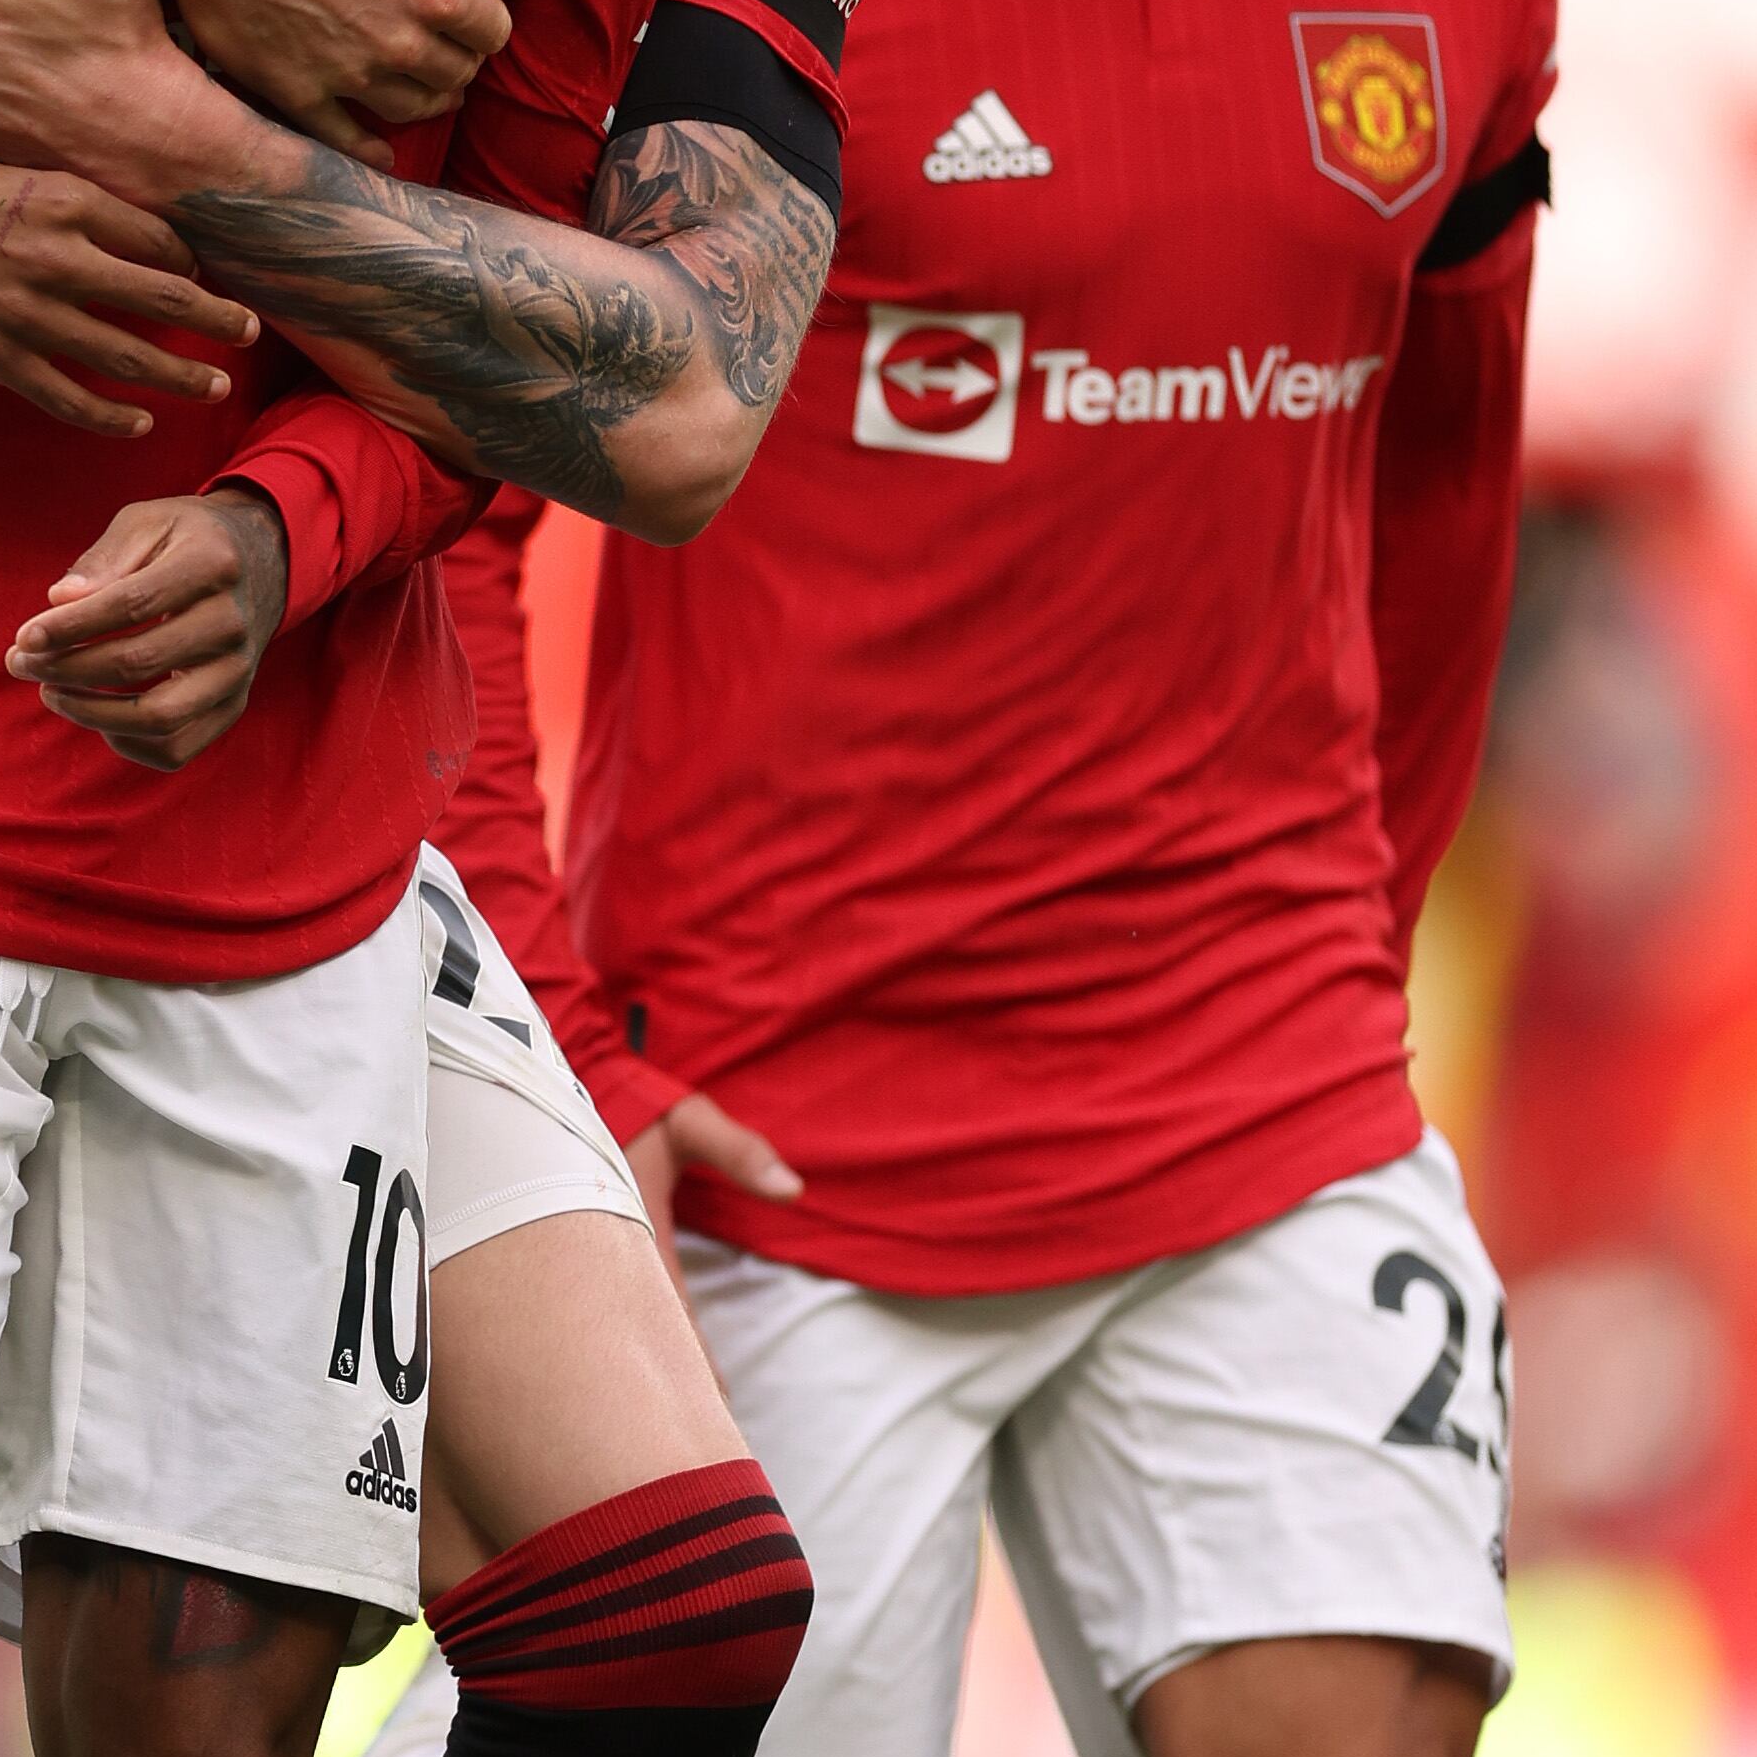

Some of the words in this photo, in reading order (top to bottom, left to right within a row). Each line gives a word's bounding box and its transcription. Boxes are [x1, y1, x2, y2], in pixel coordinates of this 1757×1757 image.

[922, 145, 1053, 184] adidas
[326, 1144, 430, 1406] 10
[345, 1469, 417, 1513] adidas
